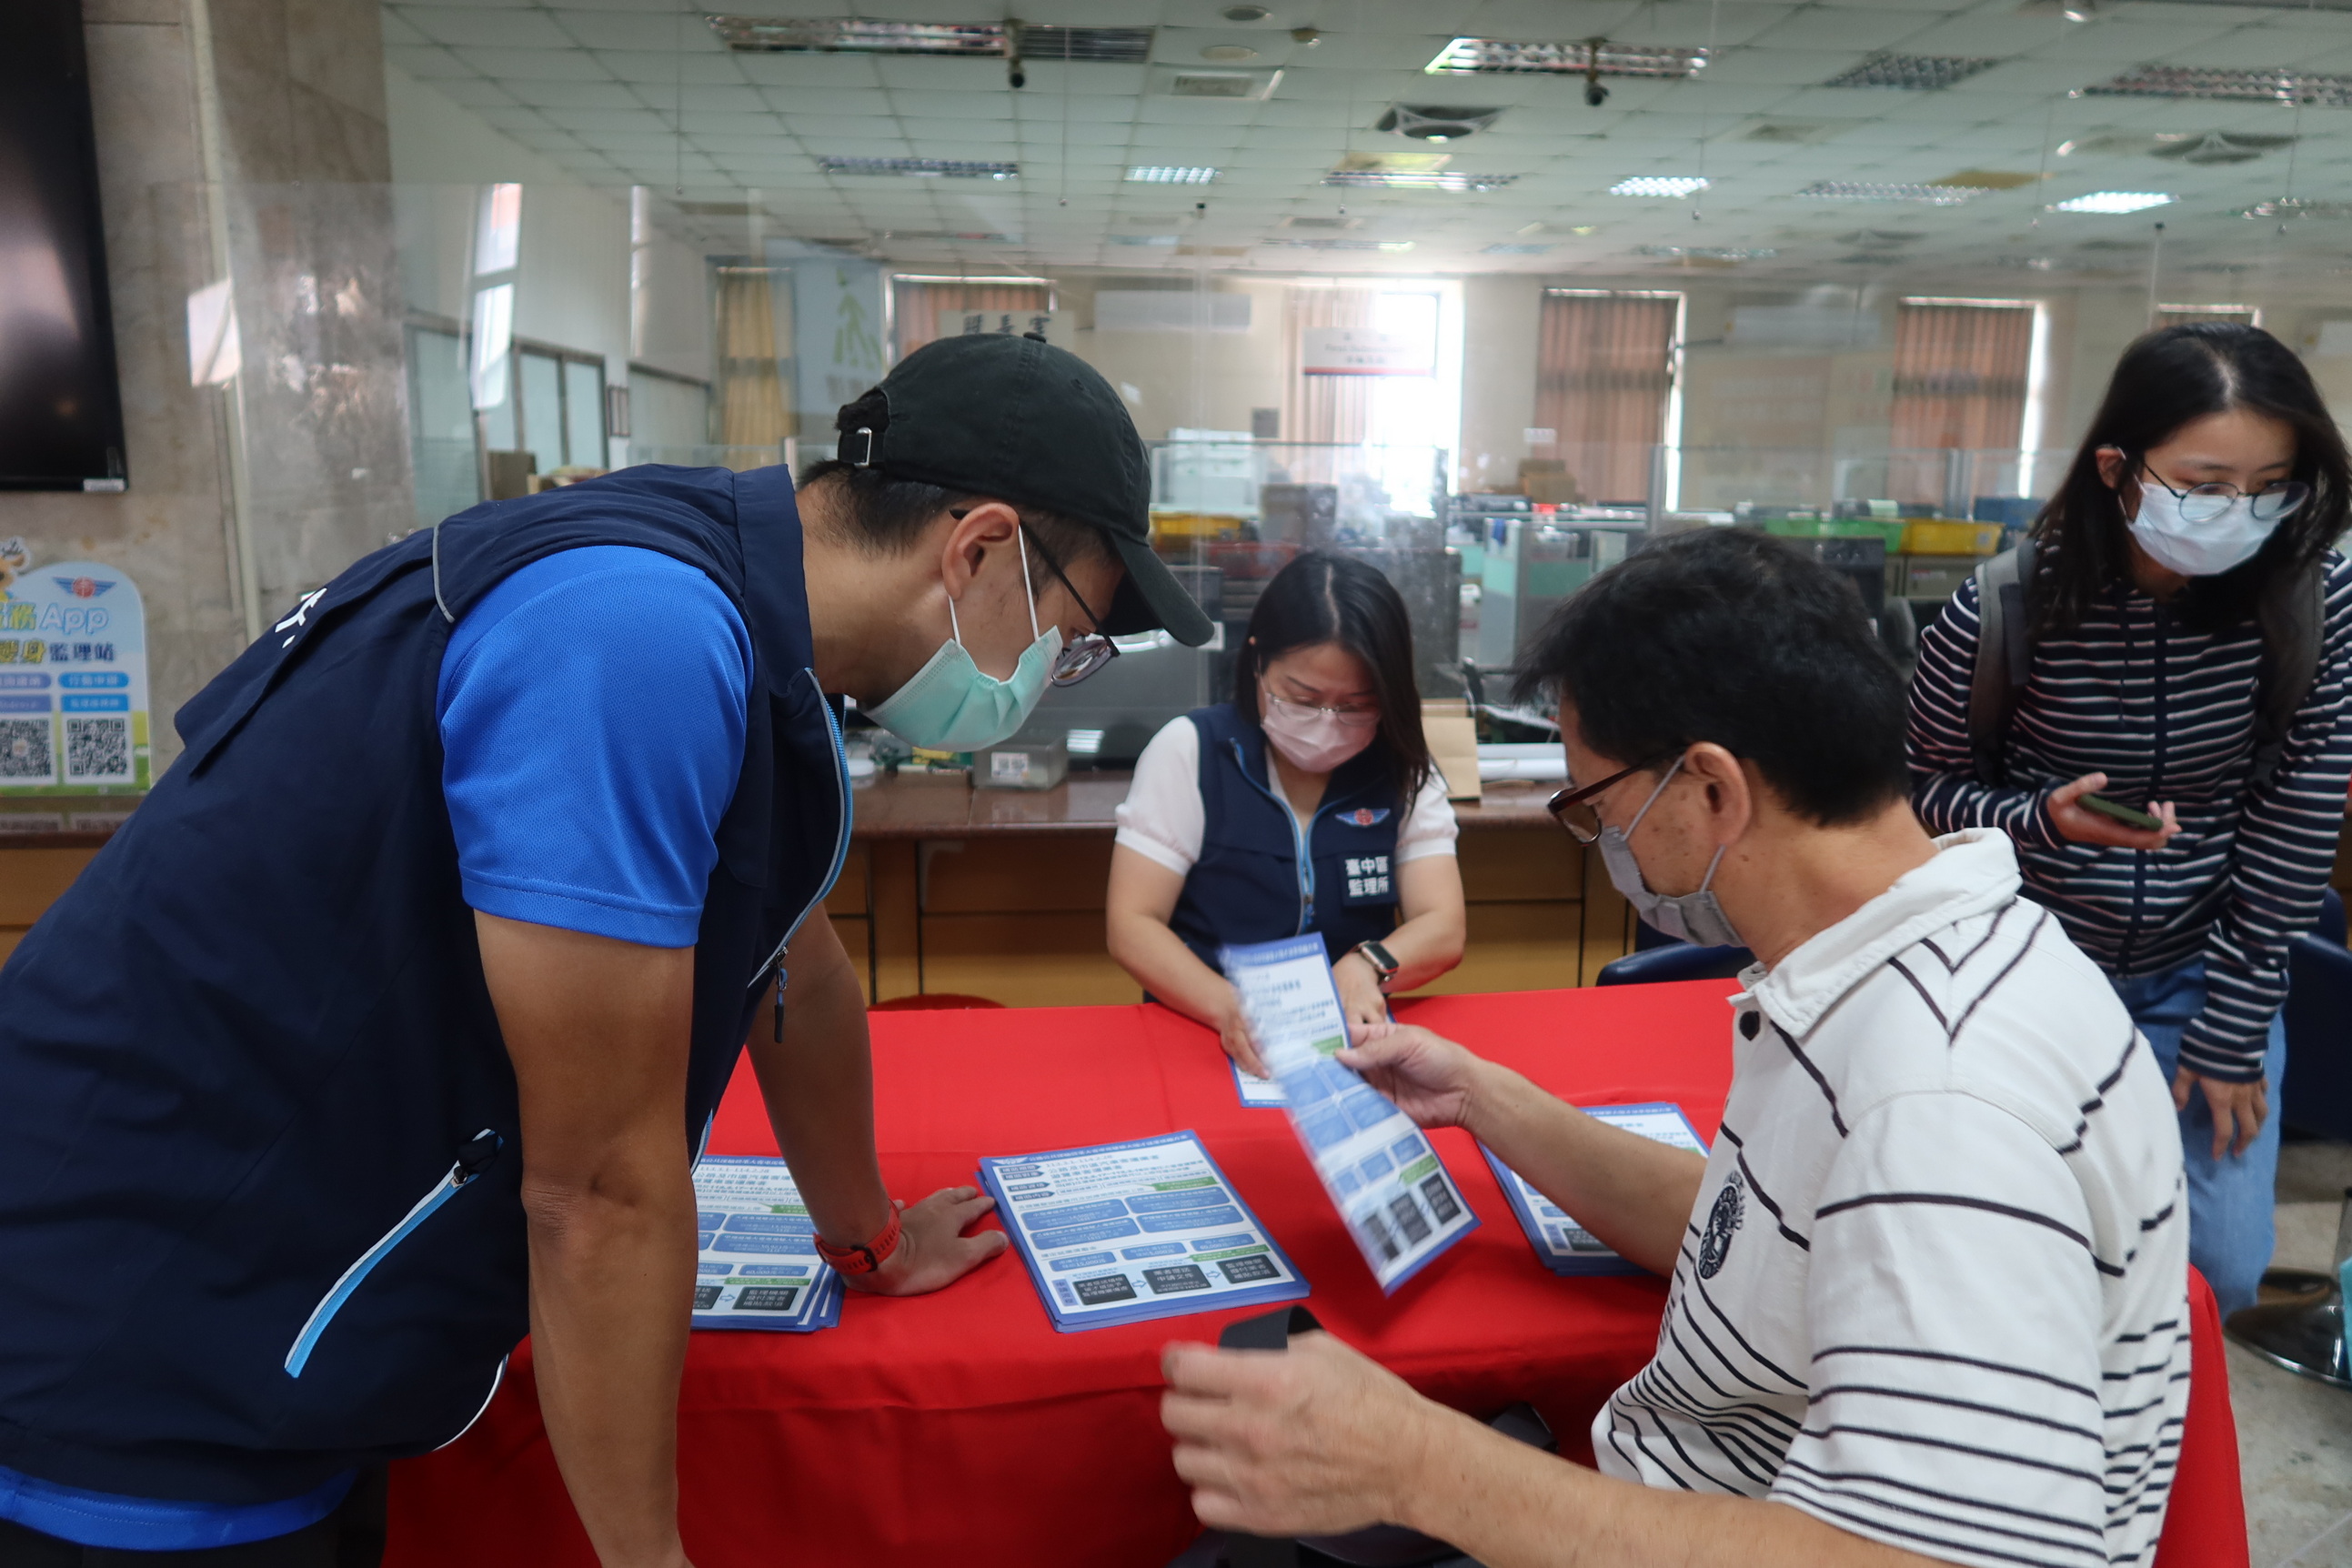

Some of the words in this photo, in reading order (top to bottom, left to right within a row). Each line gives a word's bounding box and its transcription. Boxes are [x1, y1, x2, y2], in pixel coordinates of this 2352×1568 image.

[38, 602, 110, 635] App
[1348, 876, 1389, 898] 監理所
